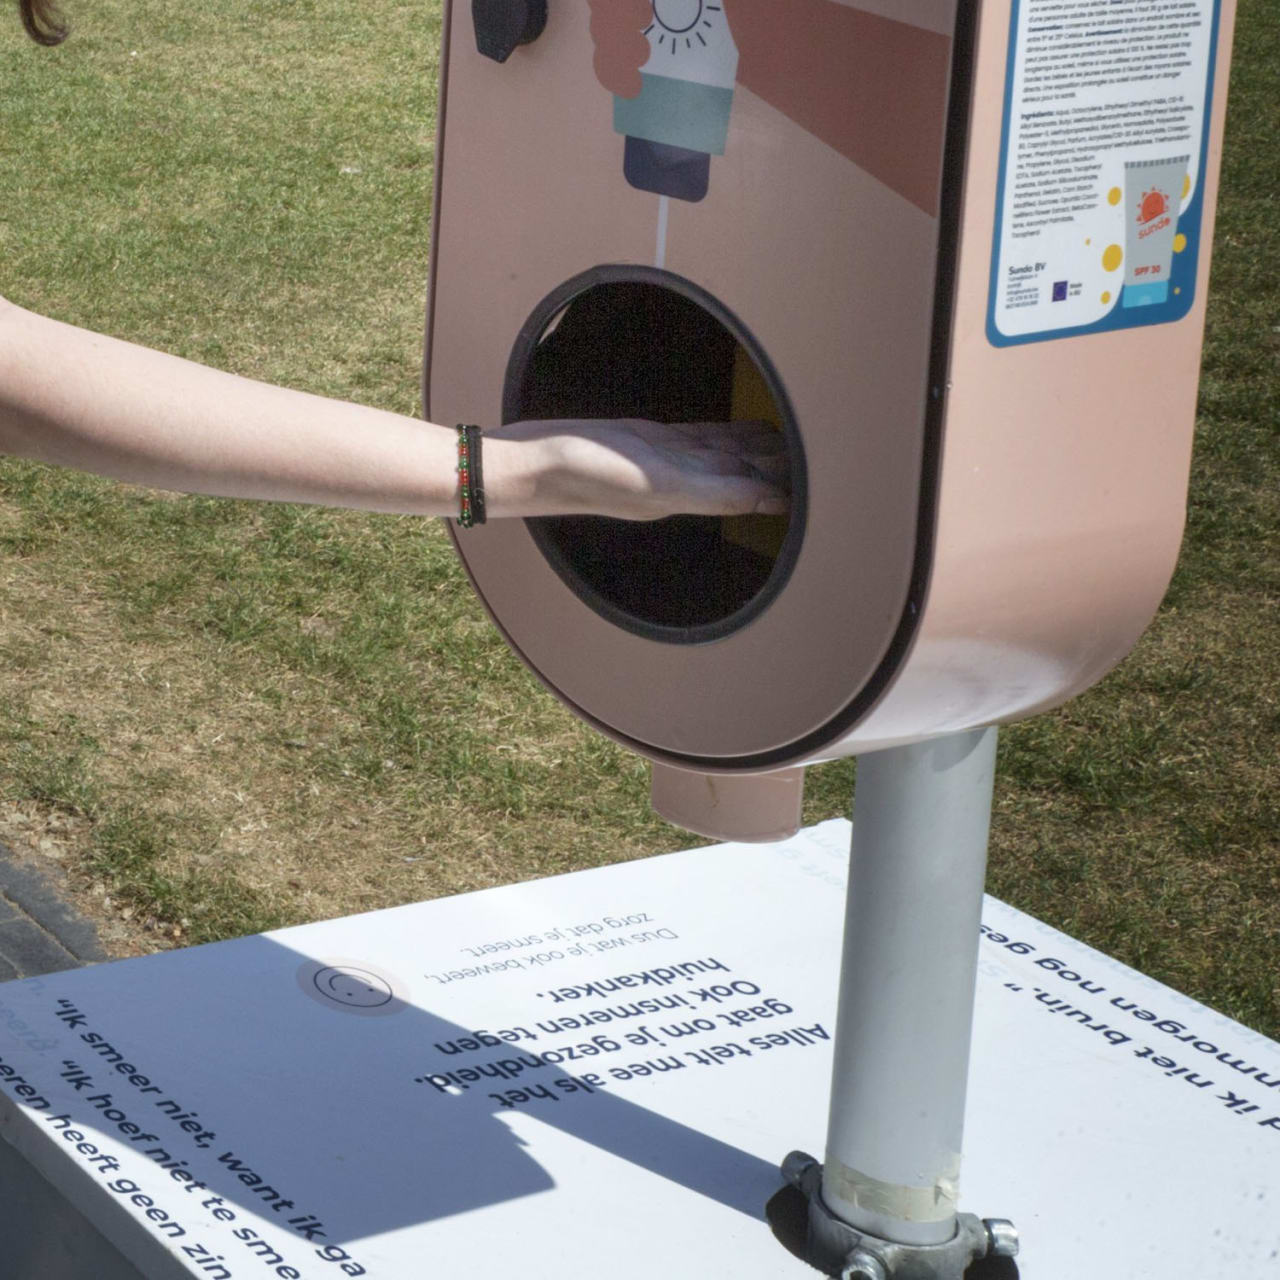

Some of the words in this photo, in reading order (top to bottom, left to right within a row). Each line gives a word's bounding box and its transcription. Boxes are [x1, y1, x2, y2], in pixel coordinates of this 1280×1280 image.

[544, 927, 569, 941] je
[566, 921, 604, 939] dat
[602, 913, 654, 930] zorg
[631, 927, 680, 942] Dus
[460, 934, 544, 957] smeert.
[523, 949, 566, 966] ook
[567, 942, 593, 956] je
[593, 936, 630, 954] wat
[423, 959, 527, 985] beweert,
[536, 957, 732, 1004] huidkanker.
[1033, 956, 1107, 995] nog
[687, 980, 761, 1004] Ook
[537, 994, 697, 1034] insmeren
[715, 998, 794, 1028] gaat
[433, 1025, 539, 1056] tegen
[624, 1026, 667, 1048] je
[658, 1018, 717, 1038] om
[748, 1023, 831, 1050] Alles
[683, 1042, 753, 1066] telt
[1109, 996, 1280, 1092] nmorgen
[414, 1034, 622, 1095] gezondheid.
[608, 1055, 688, 1081] mee
[1132, 1046, 1215, 1089] niet
[488, 1083, 560, 1109] het
[553, 1072, 607, 1095] als
[1215, 1090, 1261, 1115] ik
[80, 1032, 163, 1095] smeer
[155, 1100, 216, 1149] niet,
[218, 1151, 295, 1213] want
[288, 1215, 328, 1241] ik
[315, 1245, 367, 1278] ga
[45, 1114, 122, 1174] heeft
[106, 1179, 187, 1239] geen
[181, 1243, 233, 1280] zin
[86, 1093, 161, 1143] hoef
[145, 1146, 208, 1194] niet
[201, 1196, 237, 1222] te
[231, 1227, 302, 1280] sme
